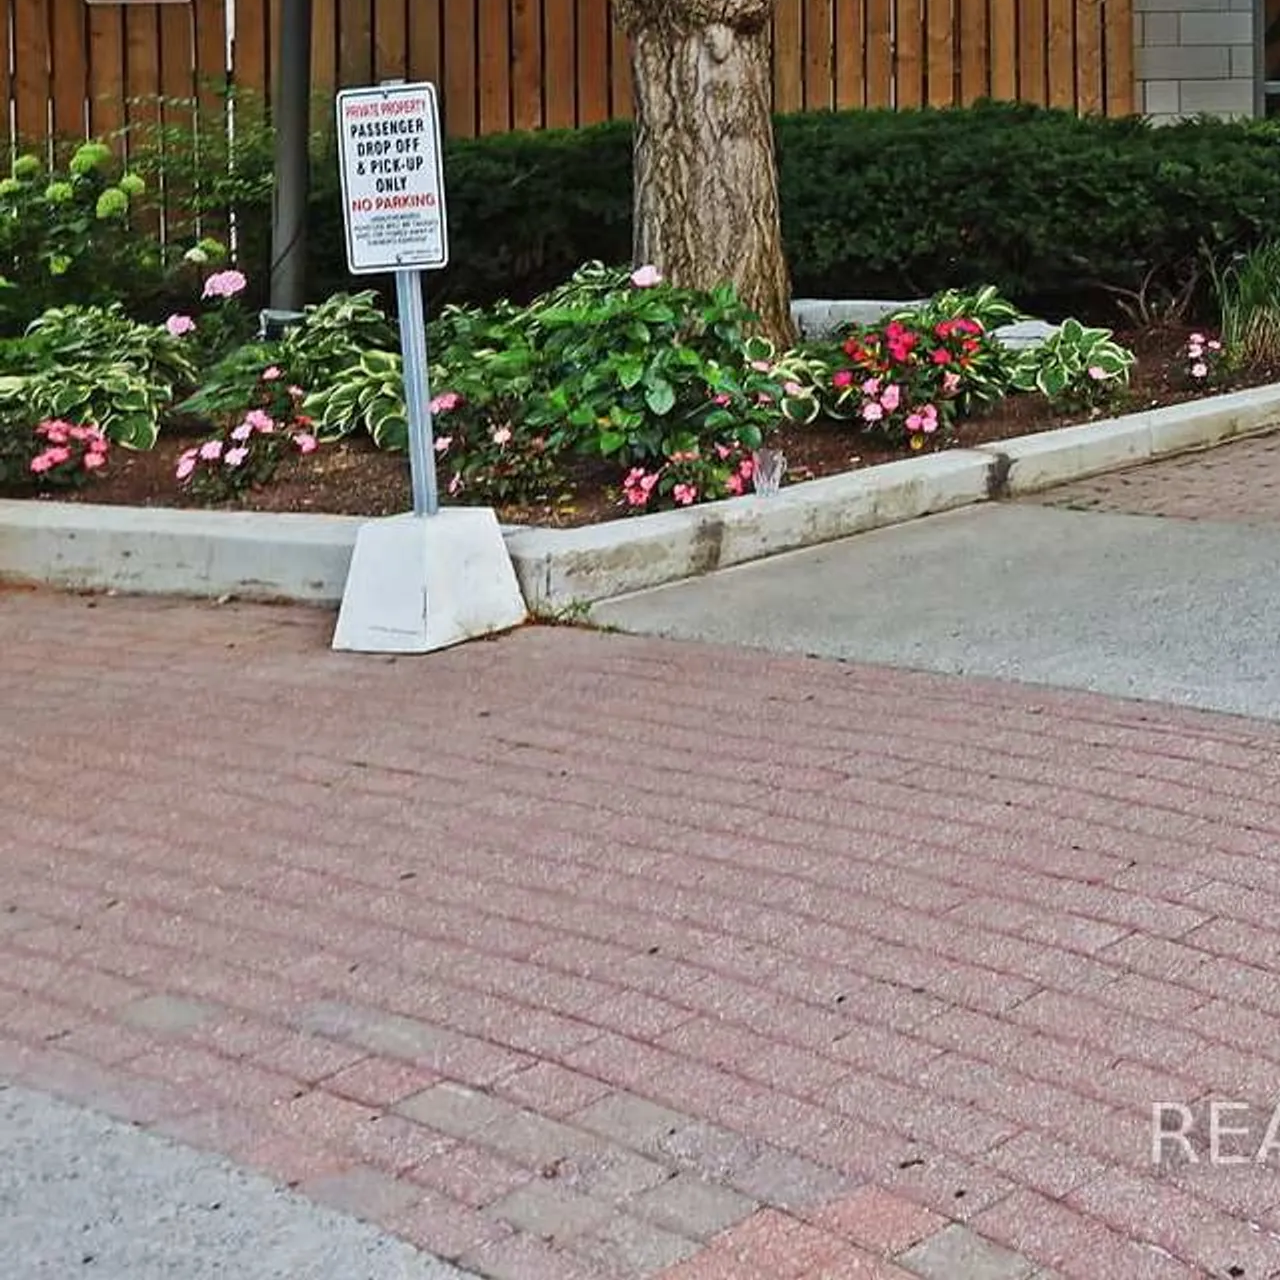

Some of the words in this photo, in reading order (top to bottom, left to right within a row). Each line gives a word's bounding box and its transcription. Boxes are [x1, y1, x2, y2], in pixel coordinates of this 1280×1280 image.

[345, 102, 379, 118] PRIVATE
[380, 99, 425, 115] PROPERTY
[350, 118, 424, 138] PASSENGER
[357, 139, 391, 157] DROP
[396, 137, 420, 153] OFF
[356, 161, 366, 175] &
[370, 155, 423, 174] PICK-UP
[376, 176, 407, 193] ONLY
[352, 197, 373, 211] NO
[375, 192, 435, 210] PARKING
